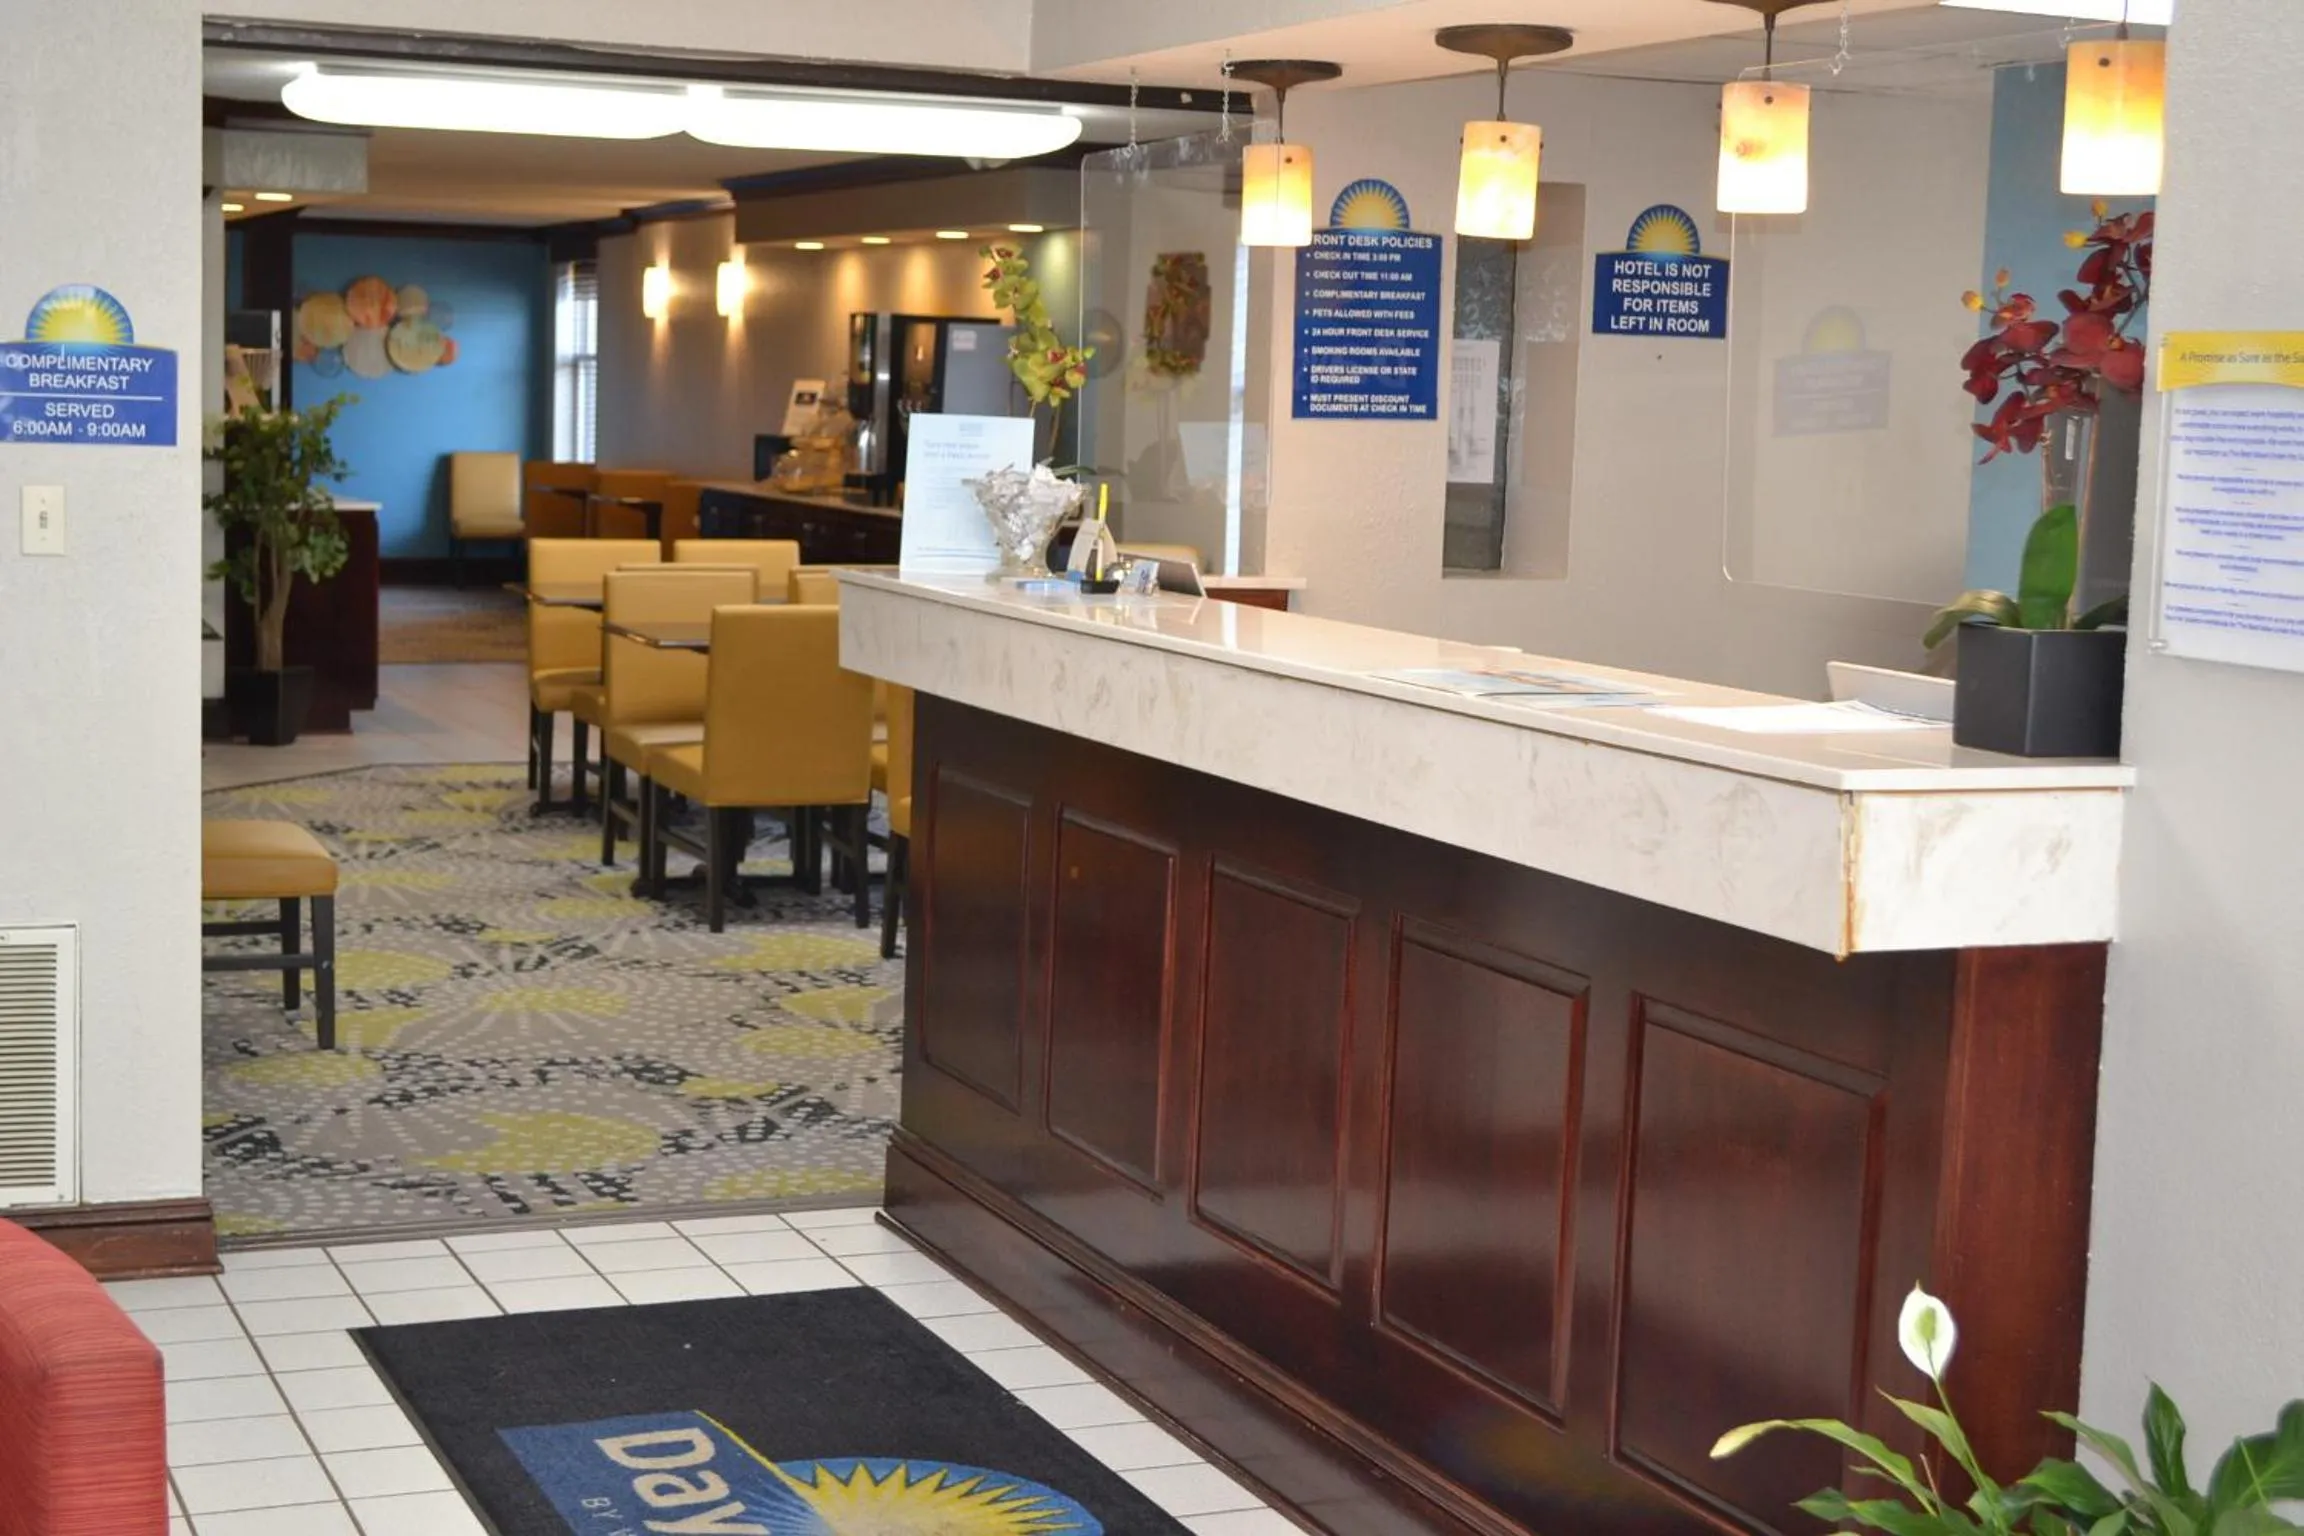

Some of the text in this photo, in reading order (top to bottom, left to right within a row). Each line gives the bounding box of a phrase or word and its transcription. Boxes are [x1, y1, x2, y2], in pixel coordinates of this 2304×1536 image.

[1313, 234, 1433, 249] RONT DESK POLICIES
[1313, 251, 1341, 261] CHECK
[1342, 252, 1351, 261] IN
[1313, 270, 1341, 280] CHECK
[1342, 271, 1358, 280] OUT
[1360, 271, 1379, 281] TIME
[1614, 260, 1712, 279] HOTEL IS NOT
[1612, 278, 1712, 297] RESPONSIBLE
[1380, 291, 1426, 301] BREAKFAST
[1623, 297, 1699, 315] FOR ITEMS
[1312, 308, 1332, 318] PETS
[1333, 308, 1372, 319] ALLOWED
[1373, 309, 1394, 319] WITH
[1610, 315, 1710, 333] LEFT IN ROOM
[1322, 327, 1345, 337] HOUR
[1346, 327, 1373, 337] FRONT
[1374, 328, 1395, 338] DESK
[1396, 329, 1430, 339] SERVICE
[1311, 346, 1421, 357] SMOKING ROOMS AVAILABLE
[6, 353, 153, 373] COMPLIMENTARY
[1311, 365, 1418, 376] DRIVERS LICENSE OR STATE
[29, 373, 130, 391] BREAKFAST
[1320, 375, 1361, 385] REQUIRED
[1310, 393, 1410, 404] MUST PRESENT DISCOUNT
[44, 402, 115, 419] SERVED
[1310, 403, 1358, 413] DOCUMENTS
[1370, 403, 1398, 413] CHECK
[1409, 404, 1427, 414] TIME
[13, 420, 72, 436] 6:00AM
[87, 421, 146, 438] 9:00AM
[581, 1497, 624, 1519] BY
